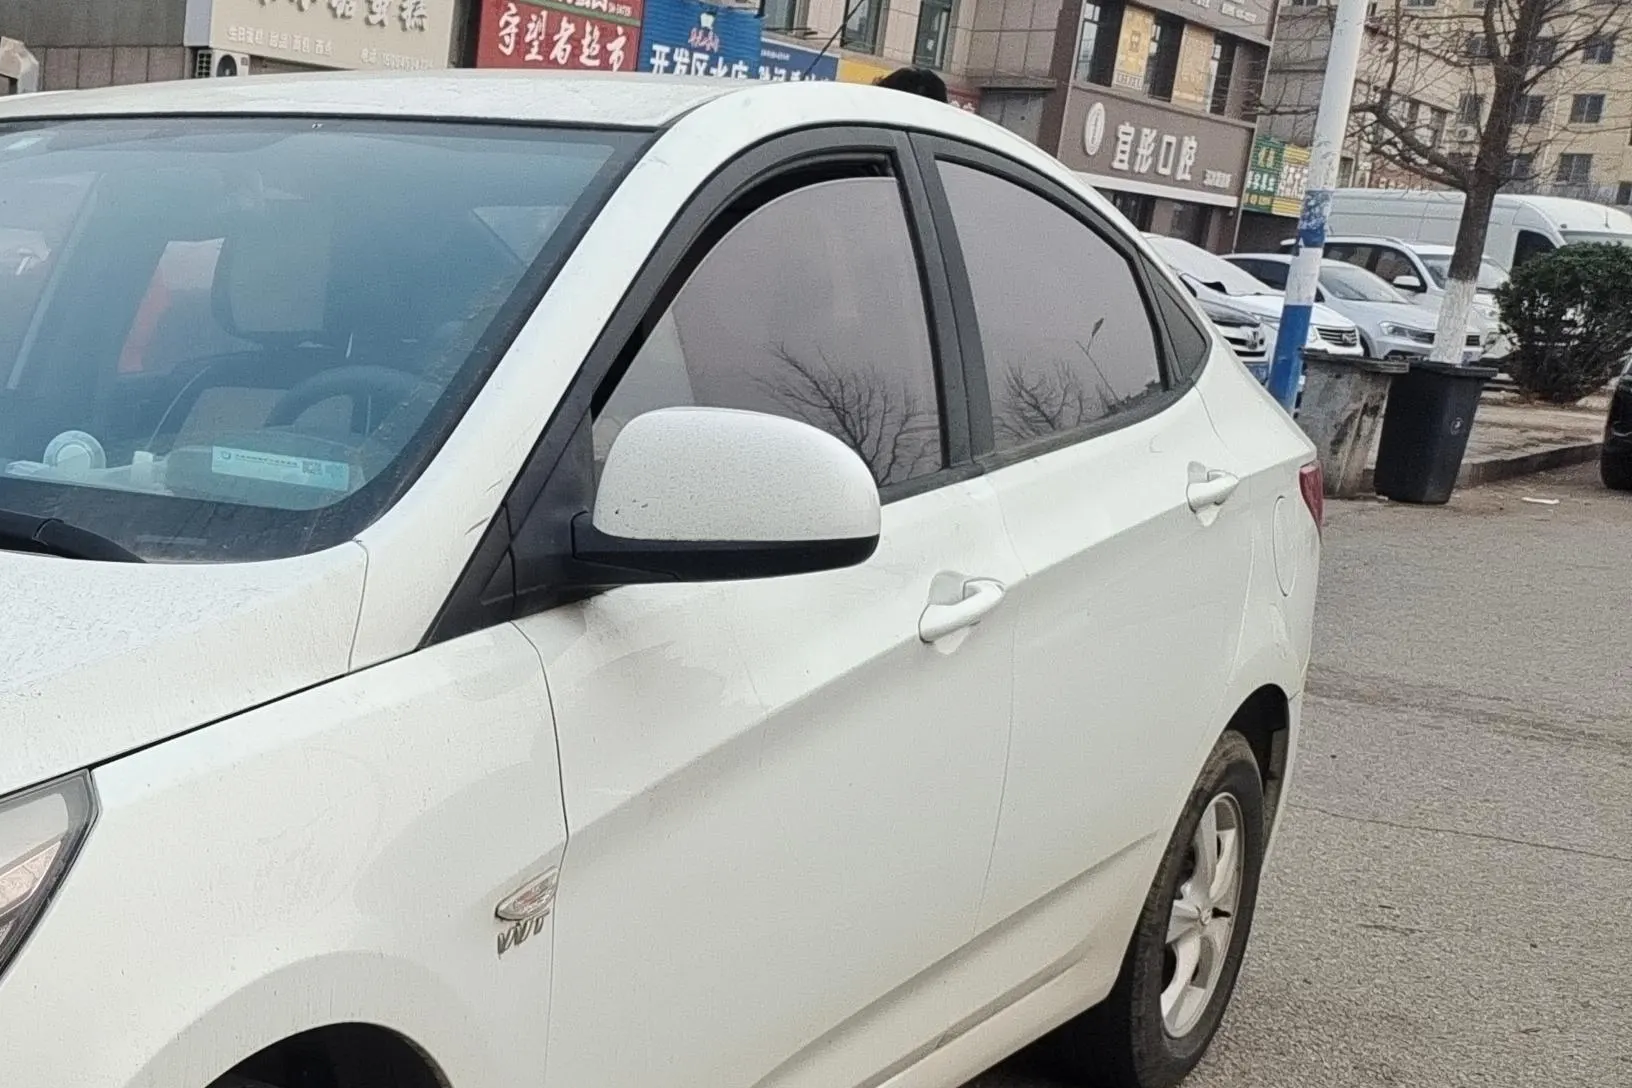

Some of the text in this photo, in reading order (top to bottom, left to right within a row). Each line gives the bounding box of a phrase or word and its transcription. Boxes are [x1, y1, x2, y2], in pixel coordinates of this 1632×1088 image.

[498, 2, 628, 72] 守望者超市
